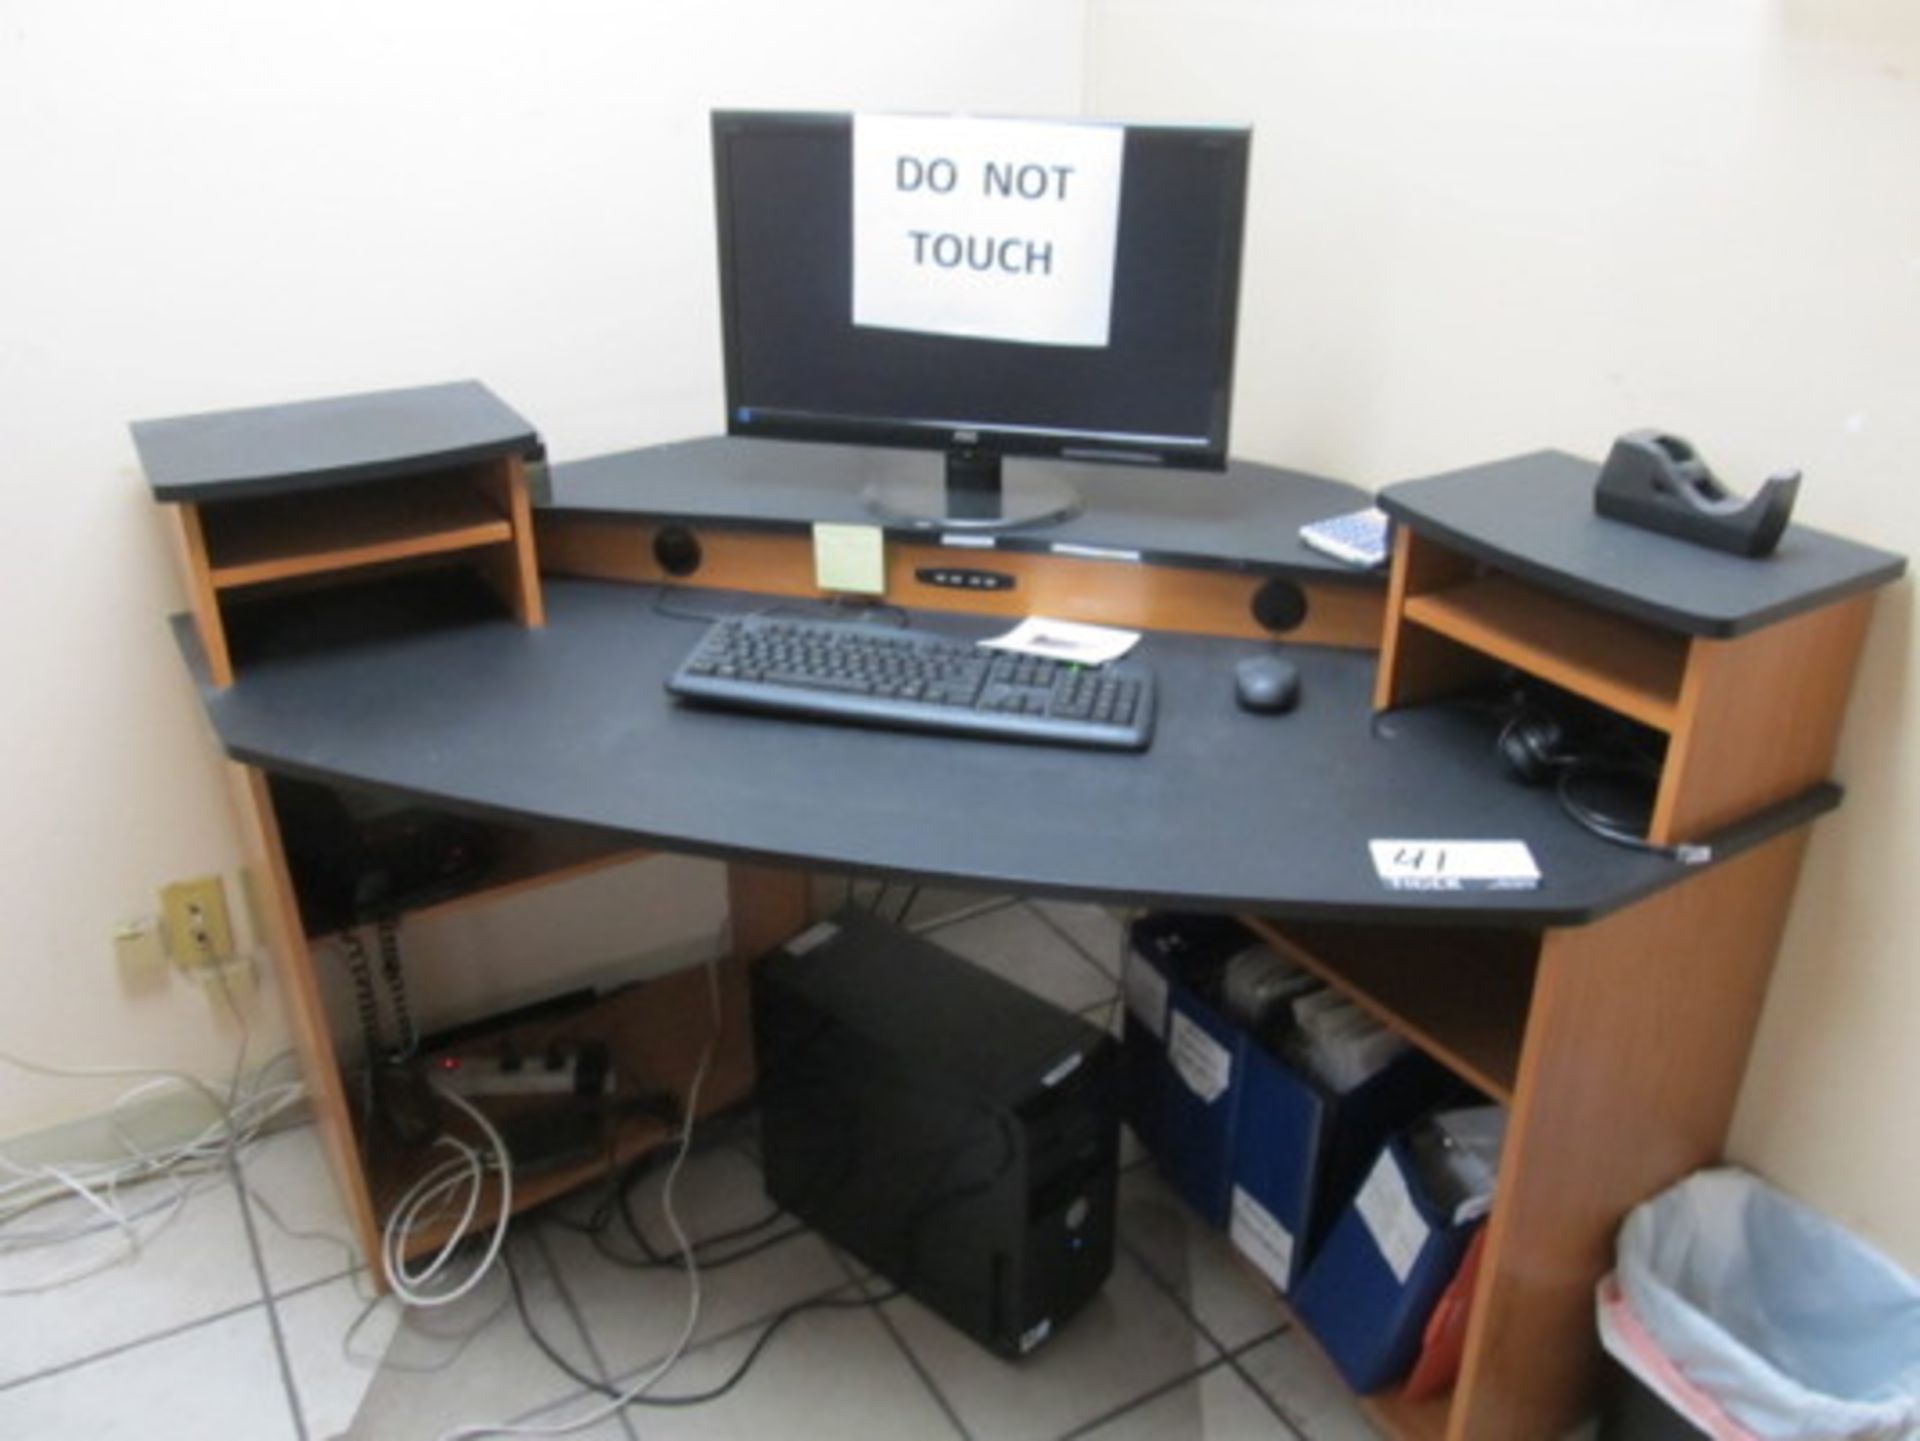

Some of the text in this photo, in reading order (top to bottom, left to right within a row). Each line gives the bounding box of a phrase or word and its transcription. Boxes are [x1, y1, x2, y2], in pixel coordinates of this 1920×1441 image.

[896, 156, 1075, 201] DO NOT
[909, 231, 1054, 275] TOUCH
[1393, 847, 1446, 871] 41
